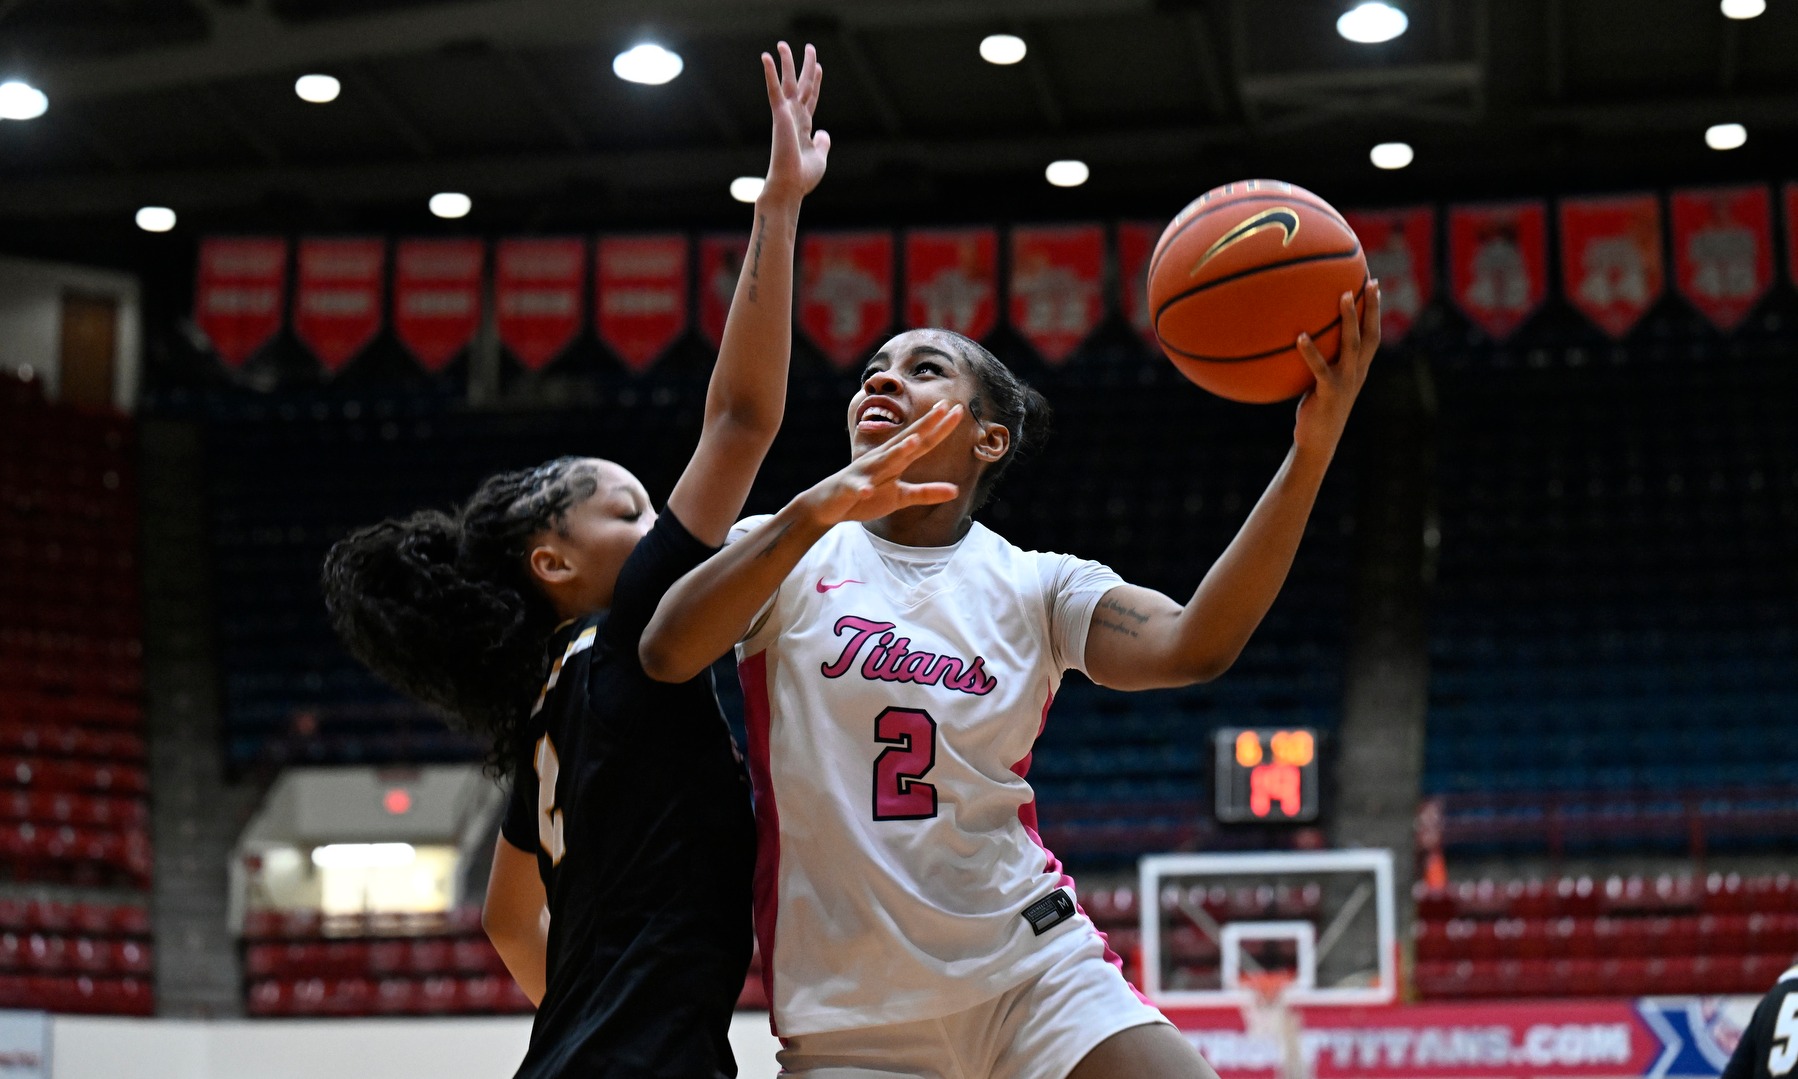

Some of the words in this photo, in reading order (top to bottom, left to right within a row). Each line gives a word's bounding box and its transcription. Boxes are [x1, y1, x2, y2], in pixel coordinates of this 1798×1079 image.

[821, 615, 998, 696] Titans
[872, 705, 938, 822] 2
[1057, 897, 1070, 910] M
[1767, 991, 1798, 1078] 5
